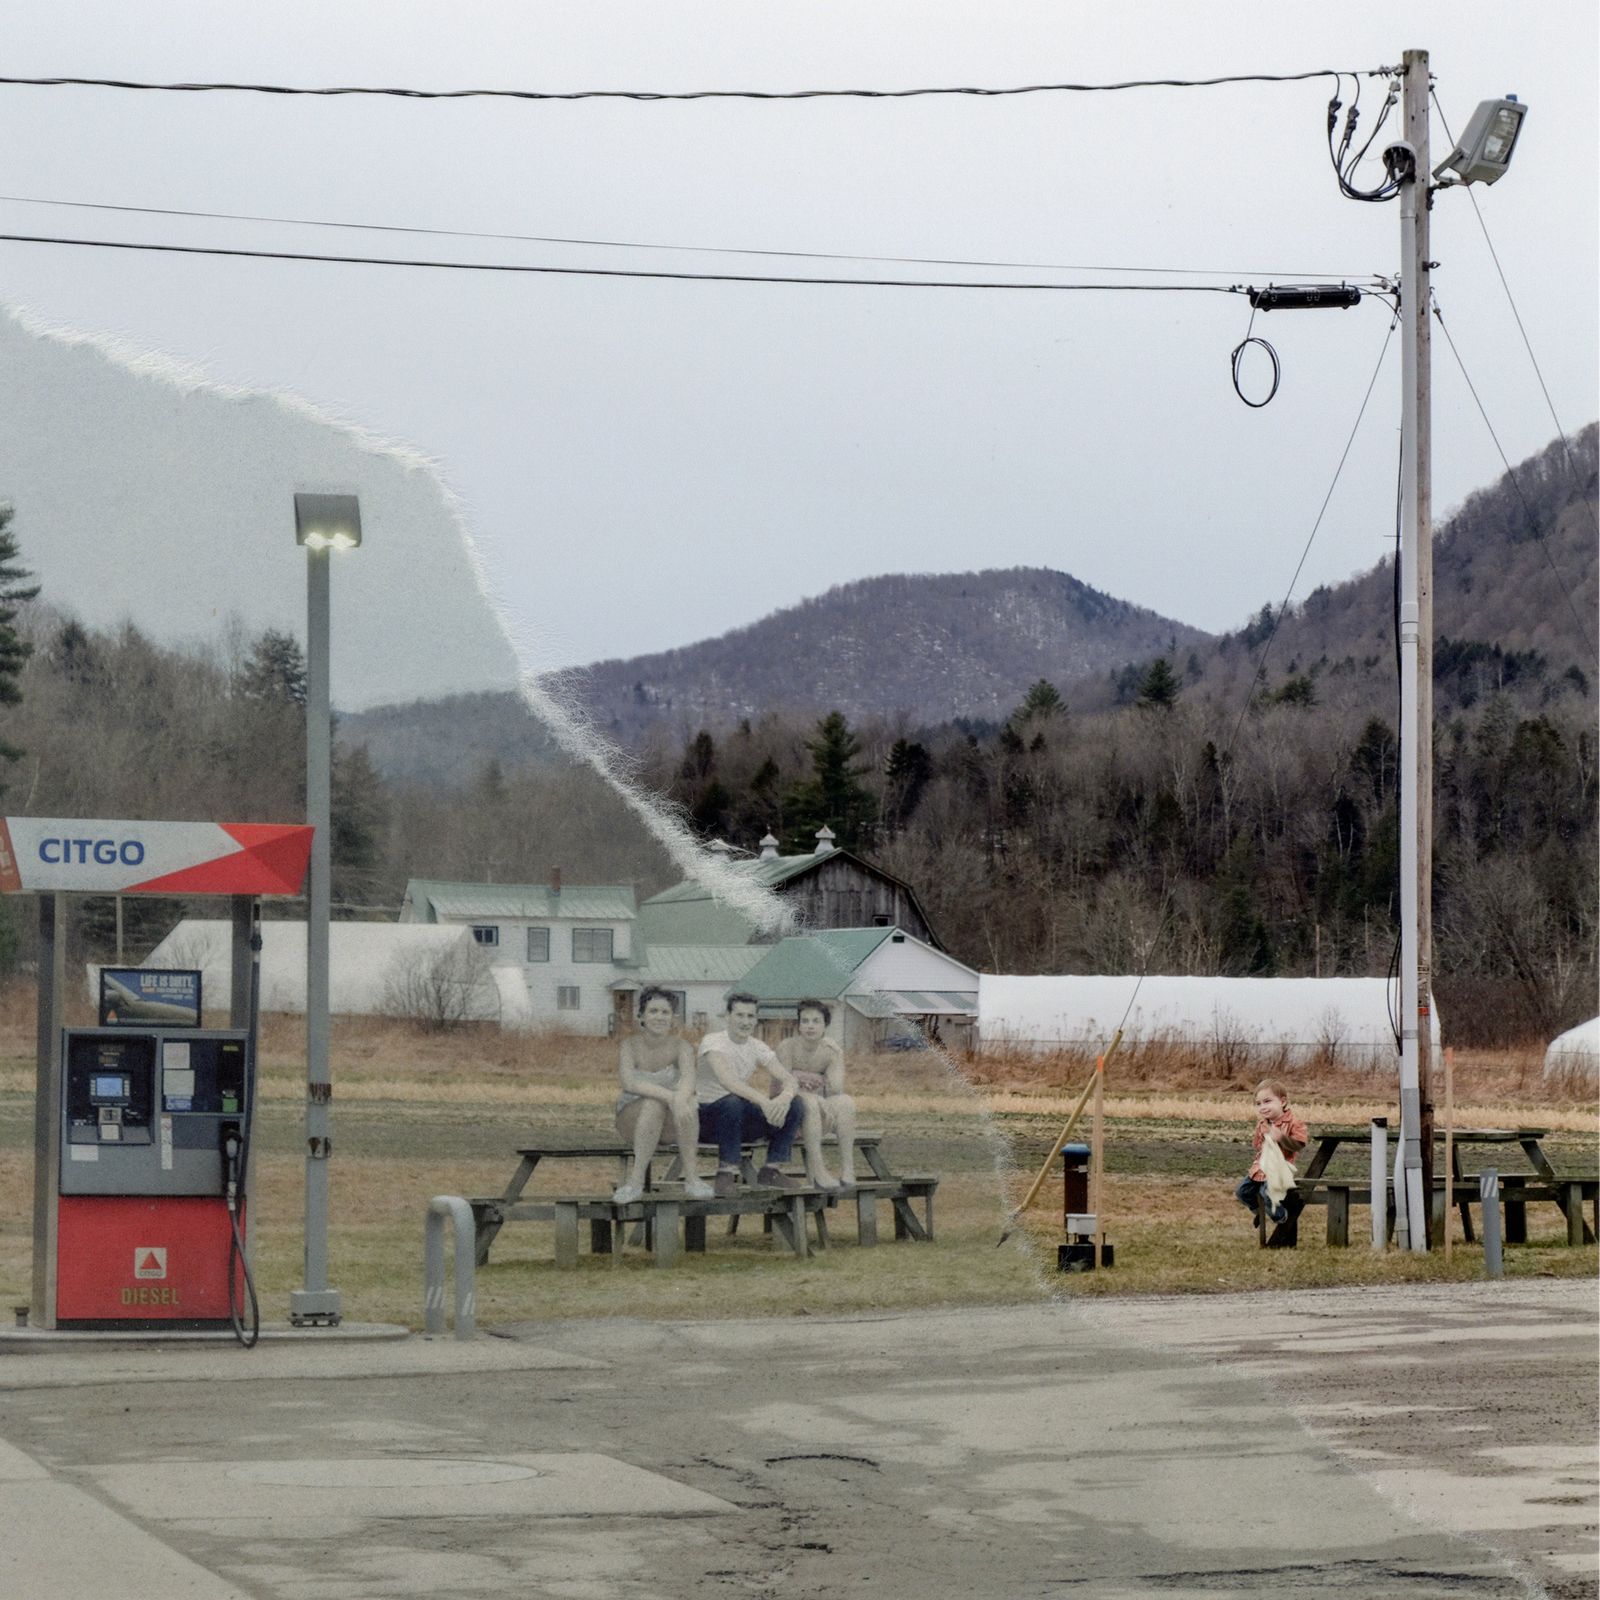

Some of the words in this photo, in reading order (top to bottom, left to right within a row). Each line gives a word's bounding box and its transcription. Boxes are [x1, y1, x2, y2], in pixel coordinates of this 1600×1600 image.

[39, 838, 145, 866] CITGO
[140, 974, 158, 988] LIFE
[159, 974, 169, 988] IS
[121, 1287, 180, 1304] DIESEL
